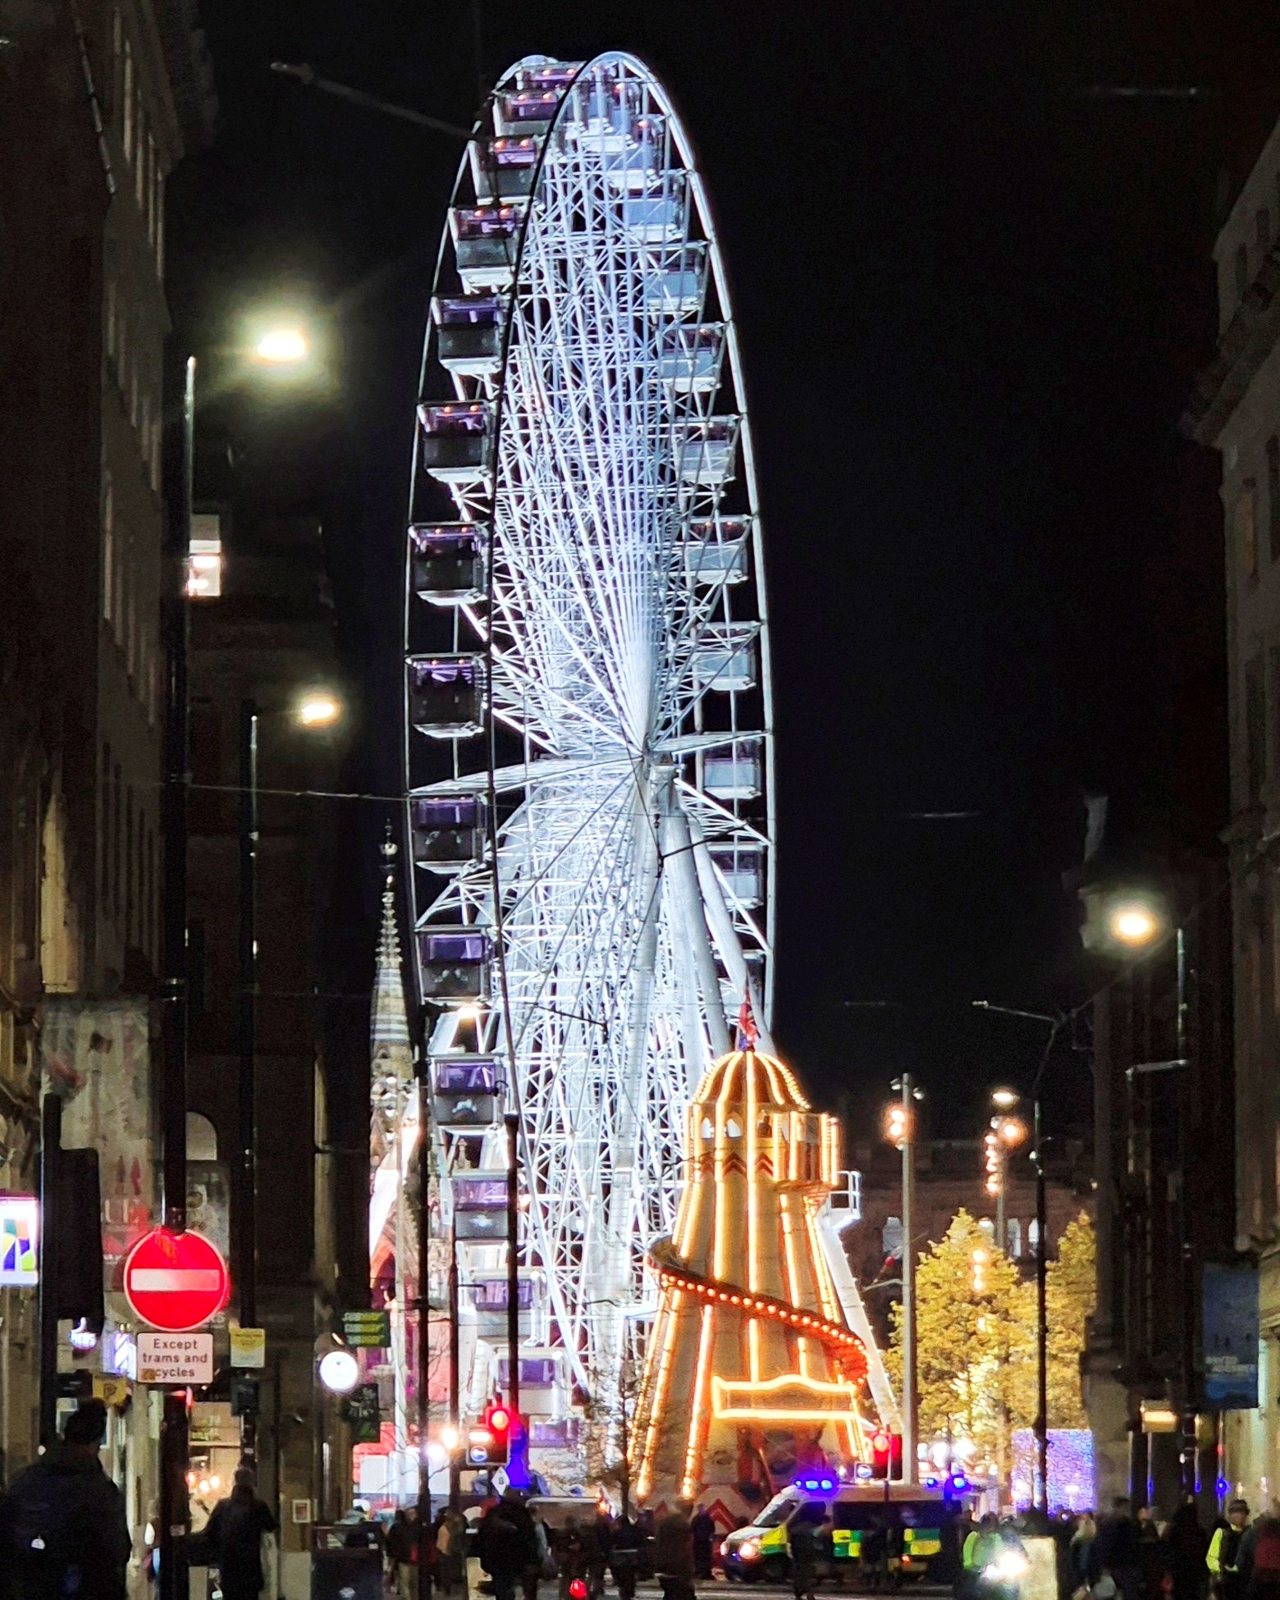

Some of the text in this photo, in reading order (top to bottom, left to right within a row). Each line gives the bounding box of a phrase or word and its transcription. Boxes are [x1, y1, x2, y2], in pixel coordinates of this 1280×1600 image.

[153, 1338, 198, 1350] Except
[142, 1352, 208, 1363] trams and
[155, 1367, 195, 1378] cycles
